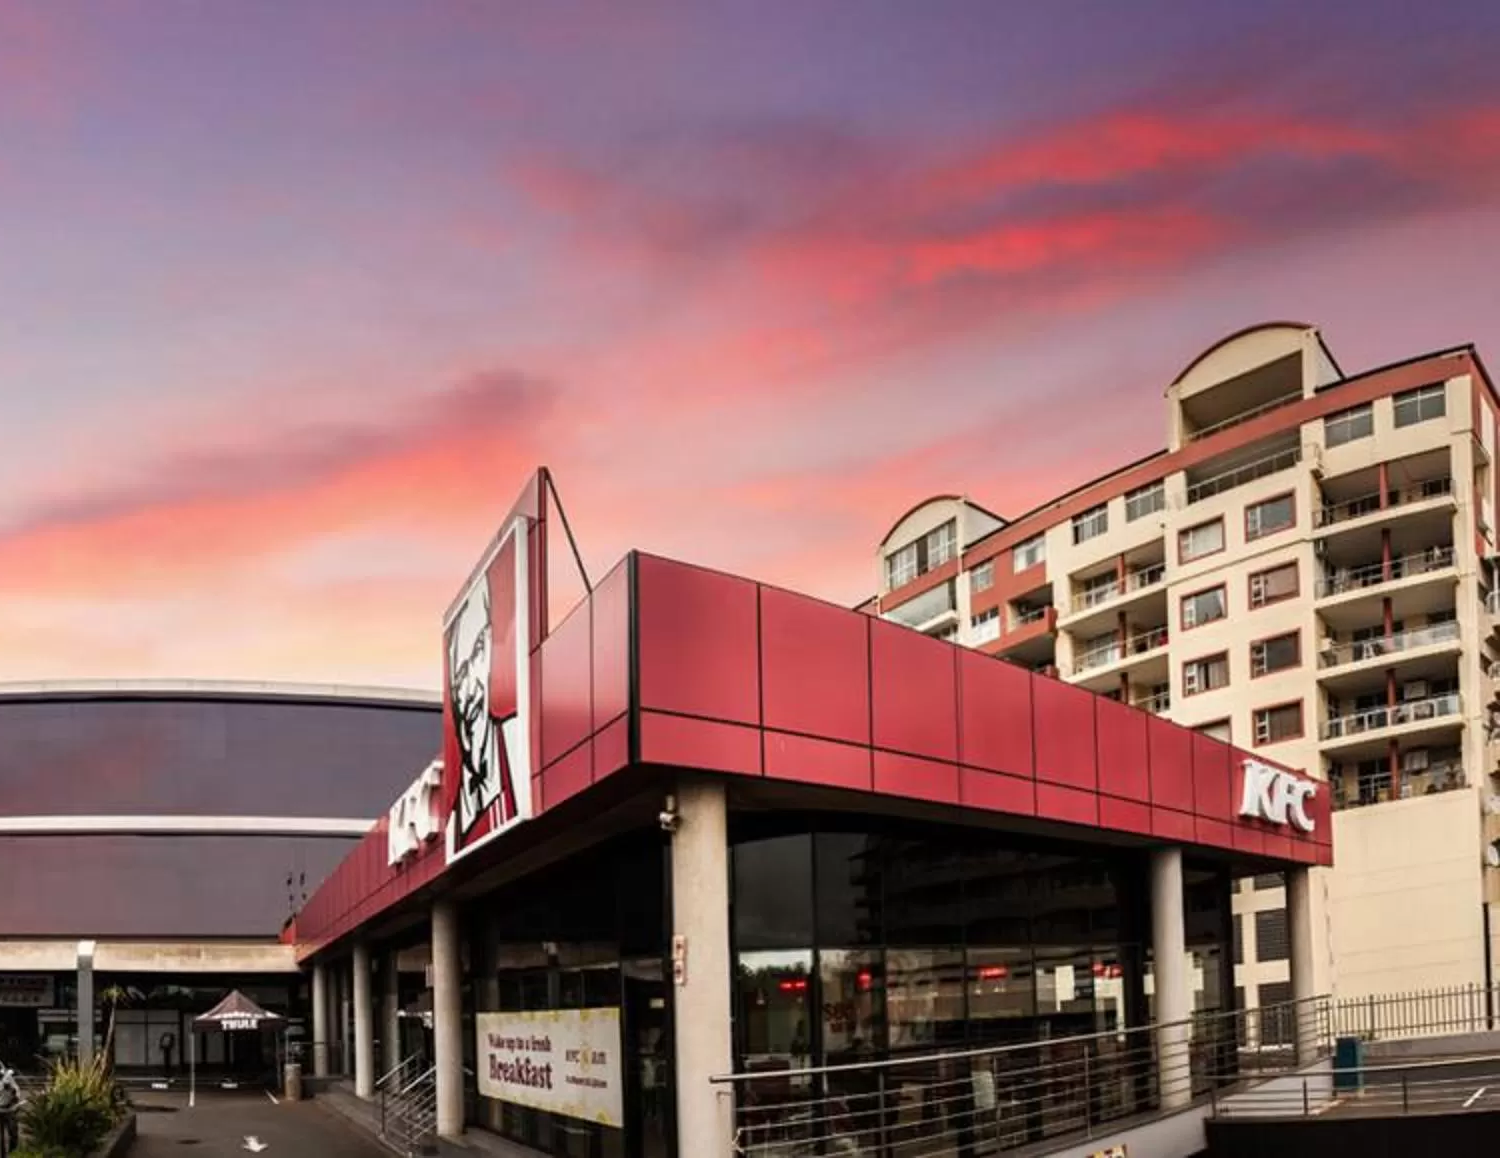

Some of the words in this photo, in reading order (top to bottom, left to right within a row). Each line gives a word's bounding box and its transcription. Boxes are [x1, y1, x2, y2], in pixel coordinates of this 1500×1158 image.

[387, 759, 445, 867] KFC
[1238, 758, 1317, 832] KFC
[220, 1018, 259, 1031] THULE
[506, 1037, 515, 1054] up
[531, 1034, 552, 1052] fresh
[489, 1053, 553, 1090] Breakfast
